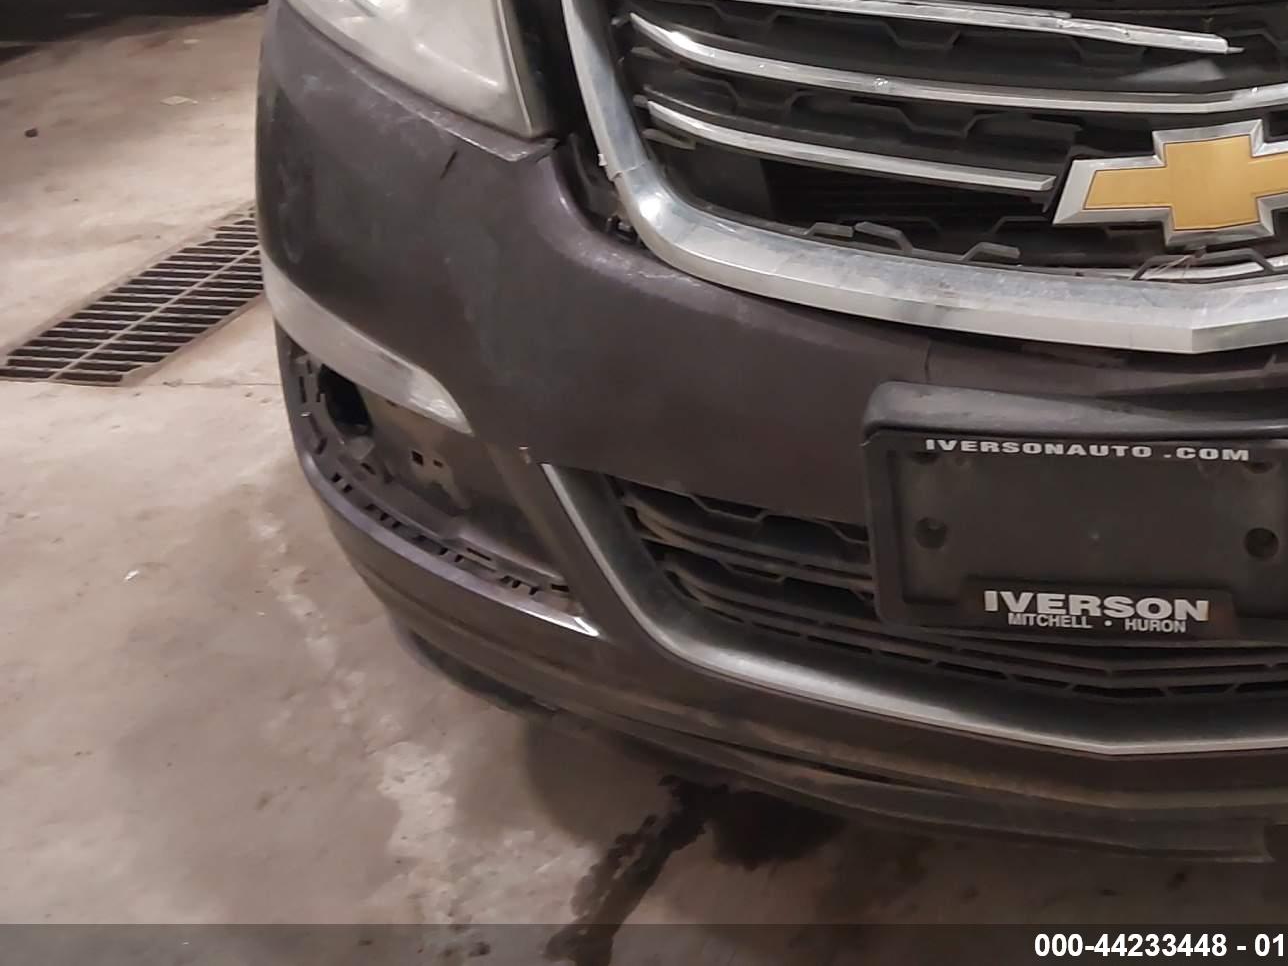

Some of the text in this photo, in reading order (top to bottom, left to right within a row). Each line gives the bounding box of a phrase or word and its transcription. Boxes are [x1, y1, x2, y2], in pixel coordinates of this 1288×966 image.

[984, 590, 1209, 622] IVERSON
[1007, 612, 1093, 629] MITCHELL
[1124, 617, 1186, 633] HURON
